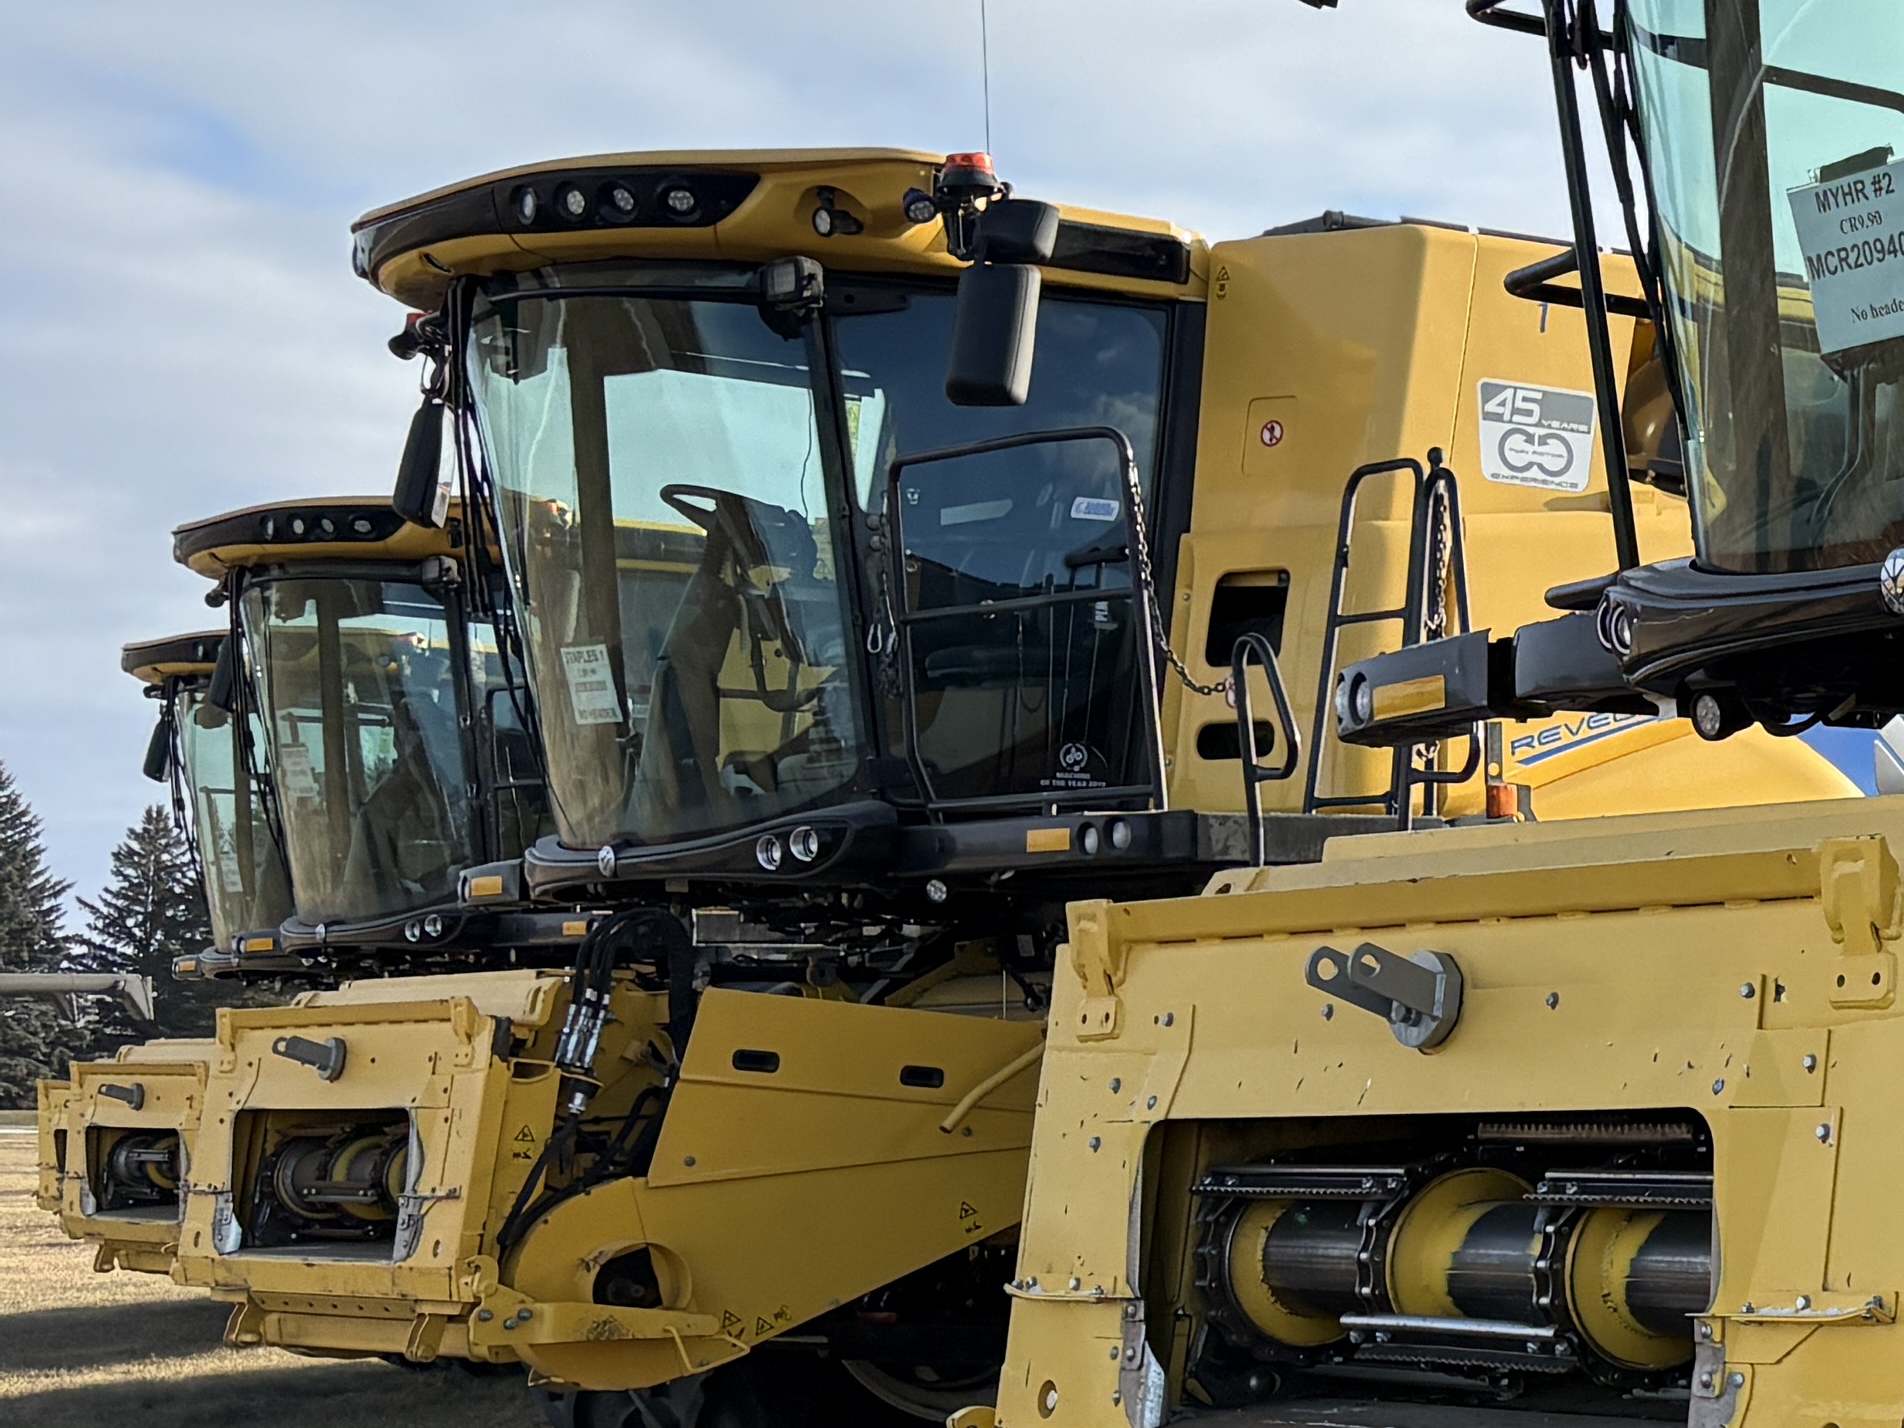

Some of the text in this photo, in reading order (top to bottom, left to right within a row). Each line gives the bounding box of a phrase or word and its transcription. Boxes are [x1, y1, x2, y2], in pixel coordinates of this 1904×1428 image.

[1814, 171, 1896, 215] MYHR #2
[1839, 210, 1883, 235] CR9.90
[1850, 305, 1868, 323] No
[1483, 387, 1590, 433] 45 YEARS
[1490, 472, 1579, 489] EXPERIENCE
